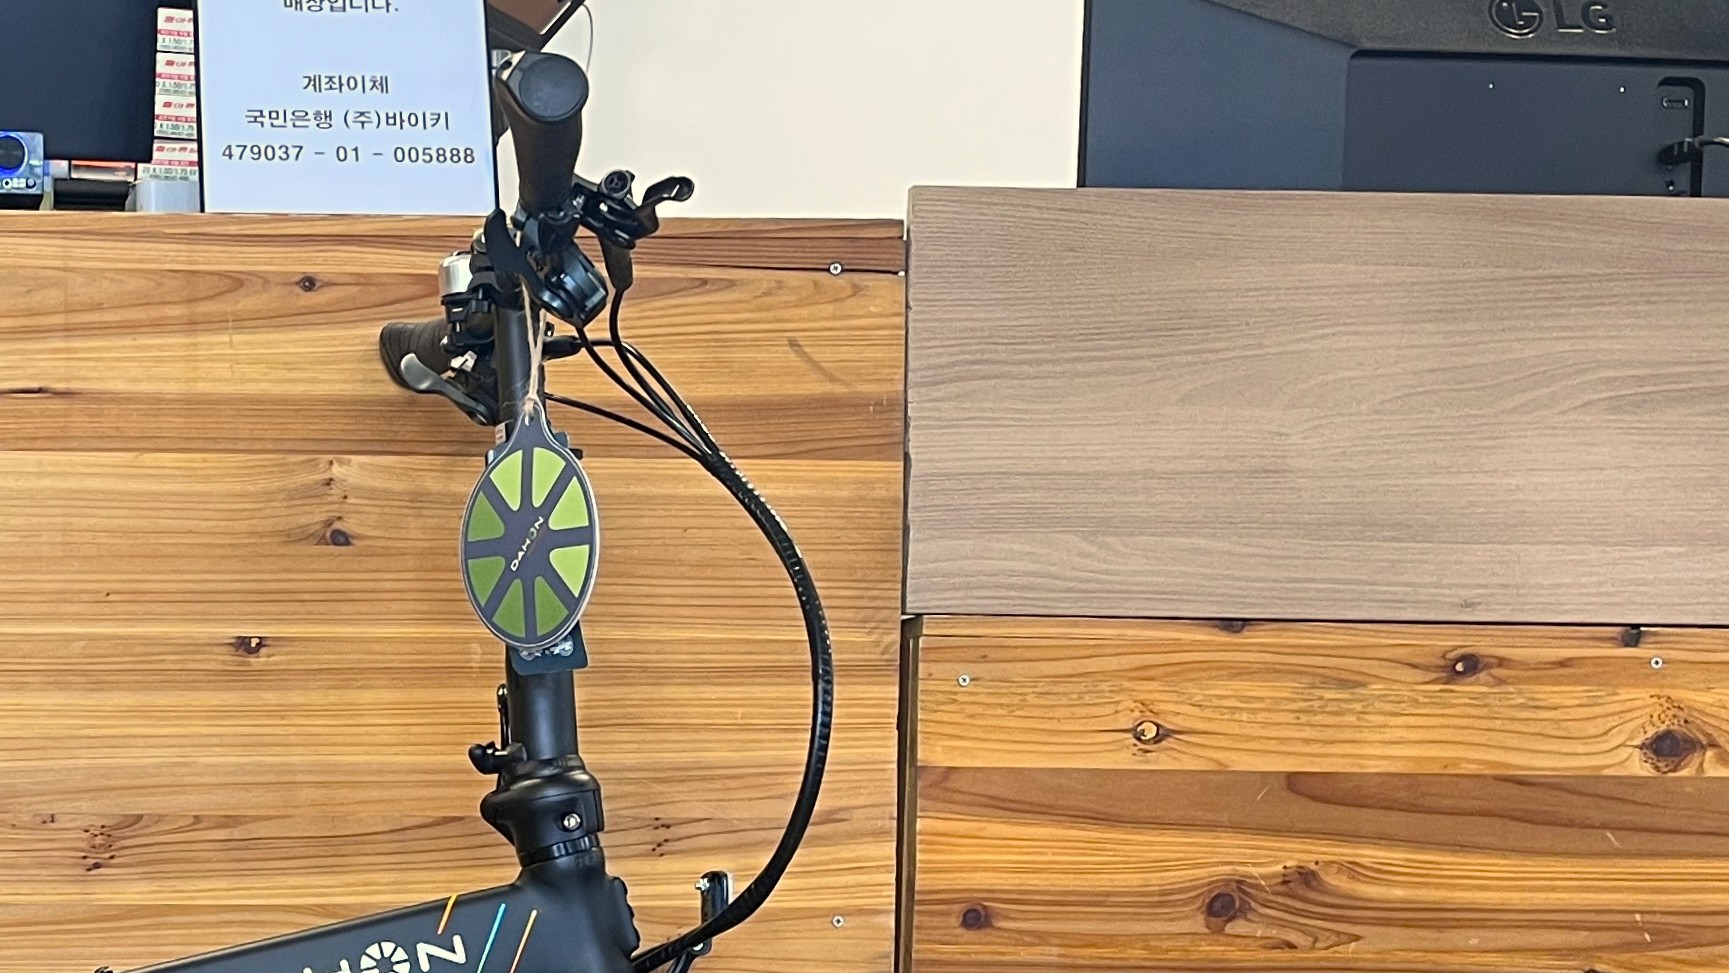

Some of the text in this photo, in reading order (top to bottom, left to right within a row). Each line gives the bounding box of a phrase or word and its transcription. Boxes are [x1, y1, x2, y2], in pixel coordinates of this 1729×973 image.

[302, 74, 390, 94] 계좌이체
[245, 109, 450, 130] 국민은행 (주)바이키
[222, 144, 304, 162] 479037
[336, 146, 360, 163] 01
[393, 147, 476, 164] 005888
[510, 515, 545, 573] DAHON
